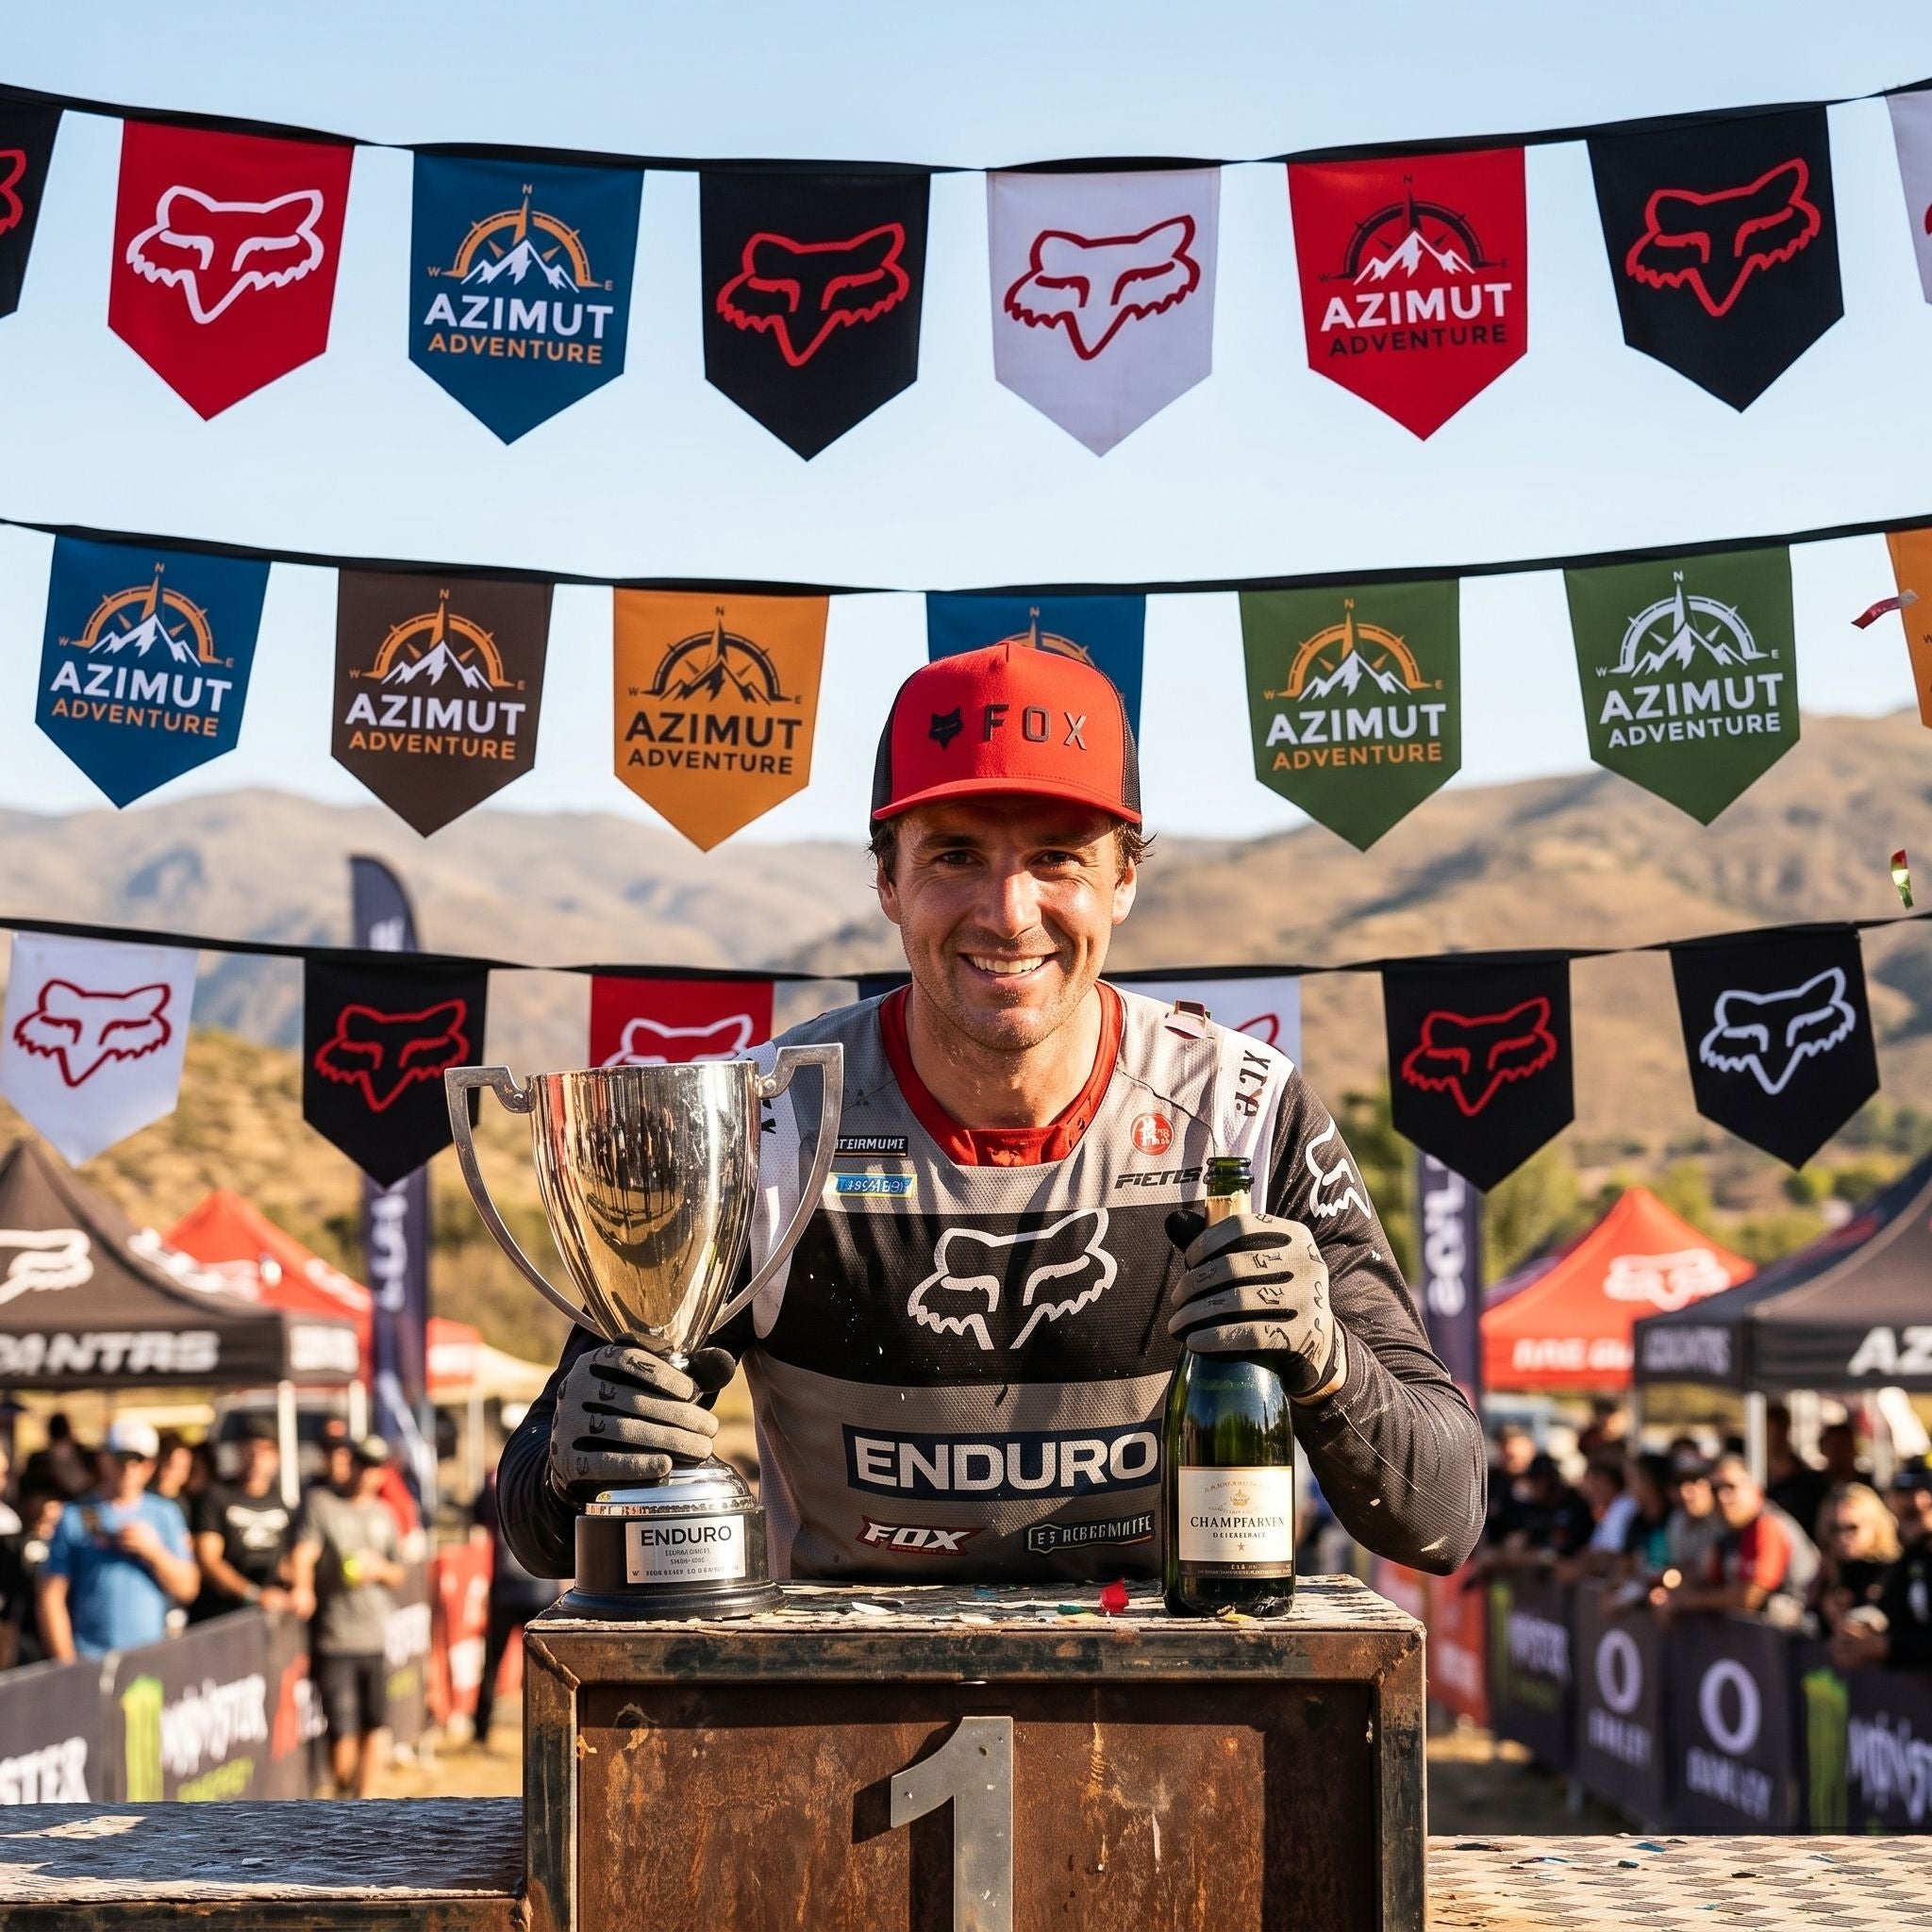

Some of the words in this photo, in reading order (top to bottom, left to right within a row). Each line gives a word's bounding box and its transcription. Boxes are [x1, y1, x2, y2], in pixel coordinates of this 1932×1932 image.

[424, 293, 613, 339] AZIMUT
[1321, 283, 1511, 332] AZIMUT
[427, 332, 602, 364] ADVENTURE
[1329, 324, 1507, 357] ADVENTURE
[50, 660, 233, 712] AZIMUT
[1599, 673, 1784, 724] AZIMUT
[52, 698, 219, 737] ADVENTURE
[344, 692, 526, 736] AZIMUT
[625, 711, 802, 750] AZIMUT
[984, 704, 1087, 750] FOX
[1265, 704, 1446, 747] AZIMUT
[1607, 712, 1781, 749] ADVENTURE
[348, 730, 516, 759] ADVENTURE
[627, 748, 793, 775] ADVENTURE
[1273, 742, 1442, 771] ADVENTURE
[855, 1431, 1158, 1491] ENDURO
[641, 1525, 731, 1546] ENDURO
[864, 1522, 971, 1550] FOX
[891, 1715, 1013, 1932] 1
